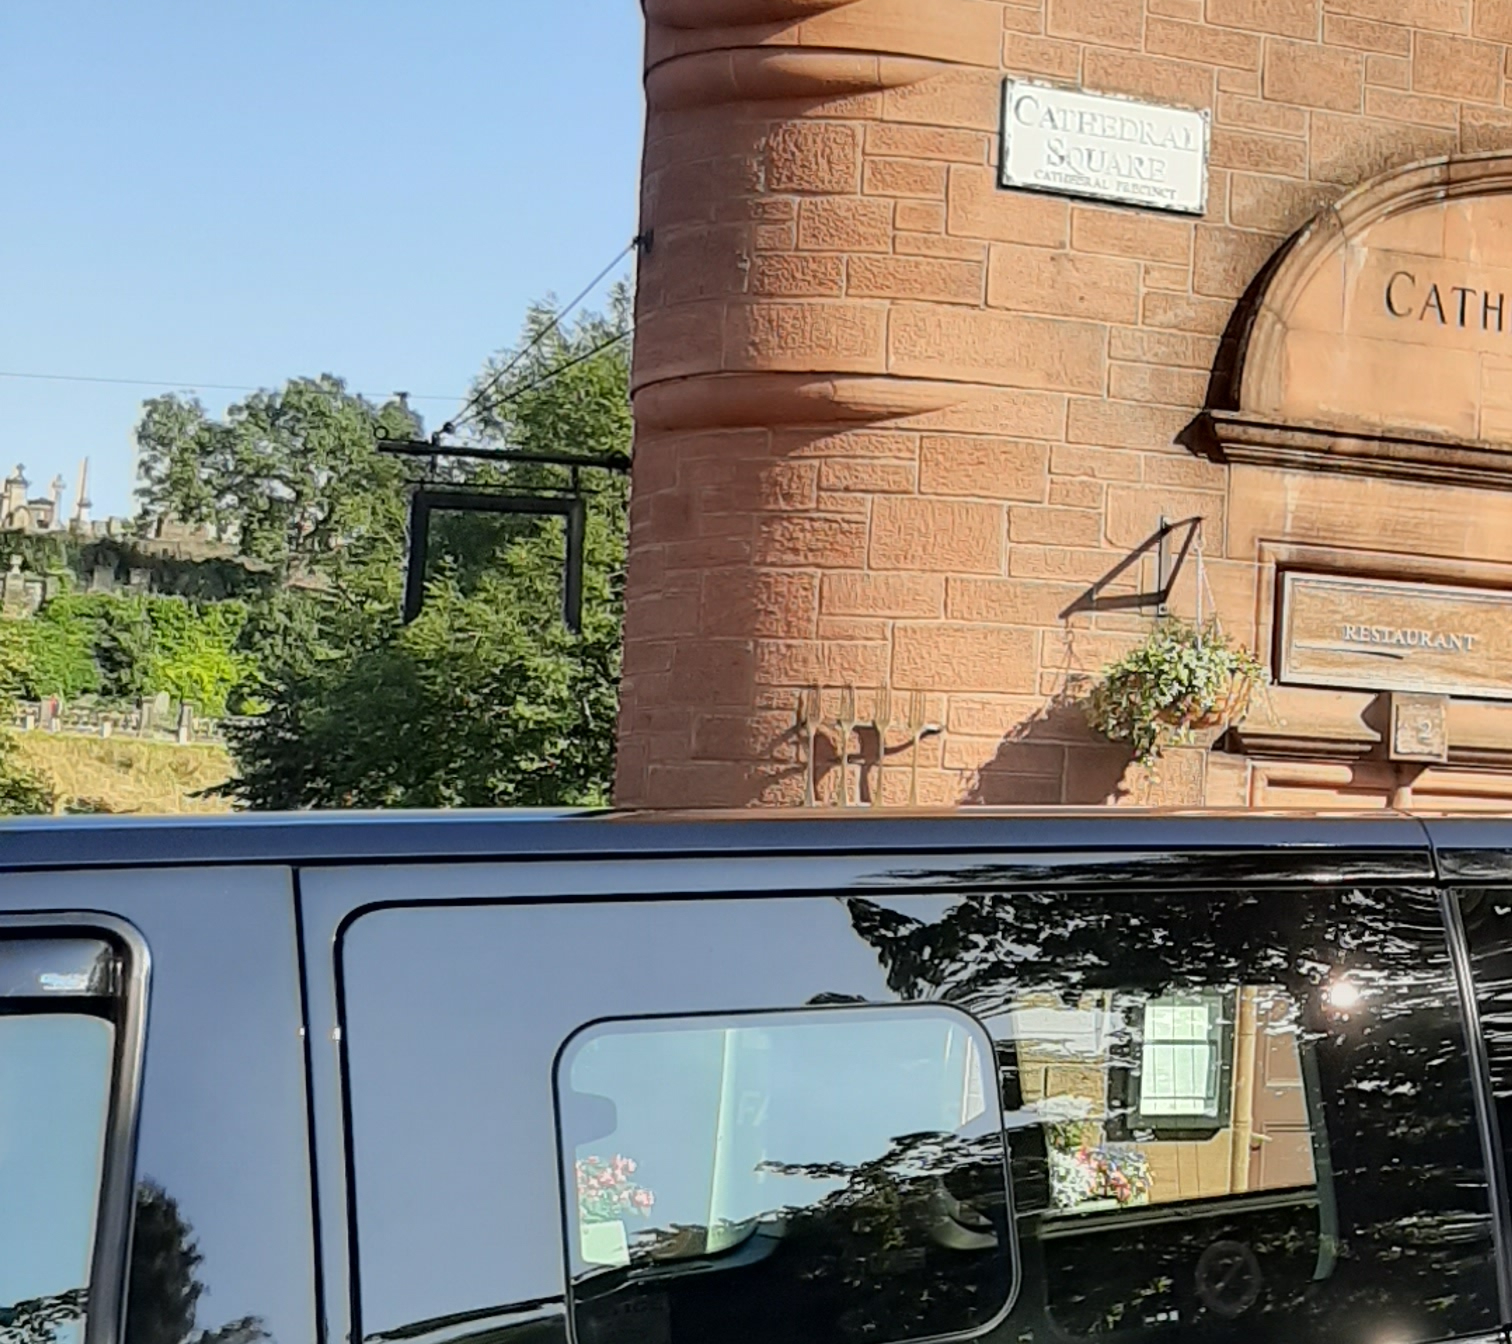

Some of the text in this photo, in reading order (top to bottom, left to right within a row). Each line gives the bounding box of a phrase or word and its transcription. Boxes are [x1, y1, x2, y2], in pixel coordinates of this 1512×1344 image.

[1014, 94, 1199, 153] CATHEDRAL
[1047, 137, 1167, 184] SQUARE
[1342, 623, 1478, 652] RESTAURANT
